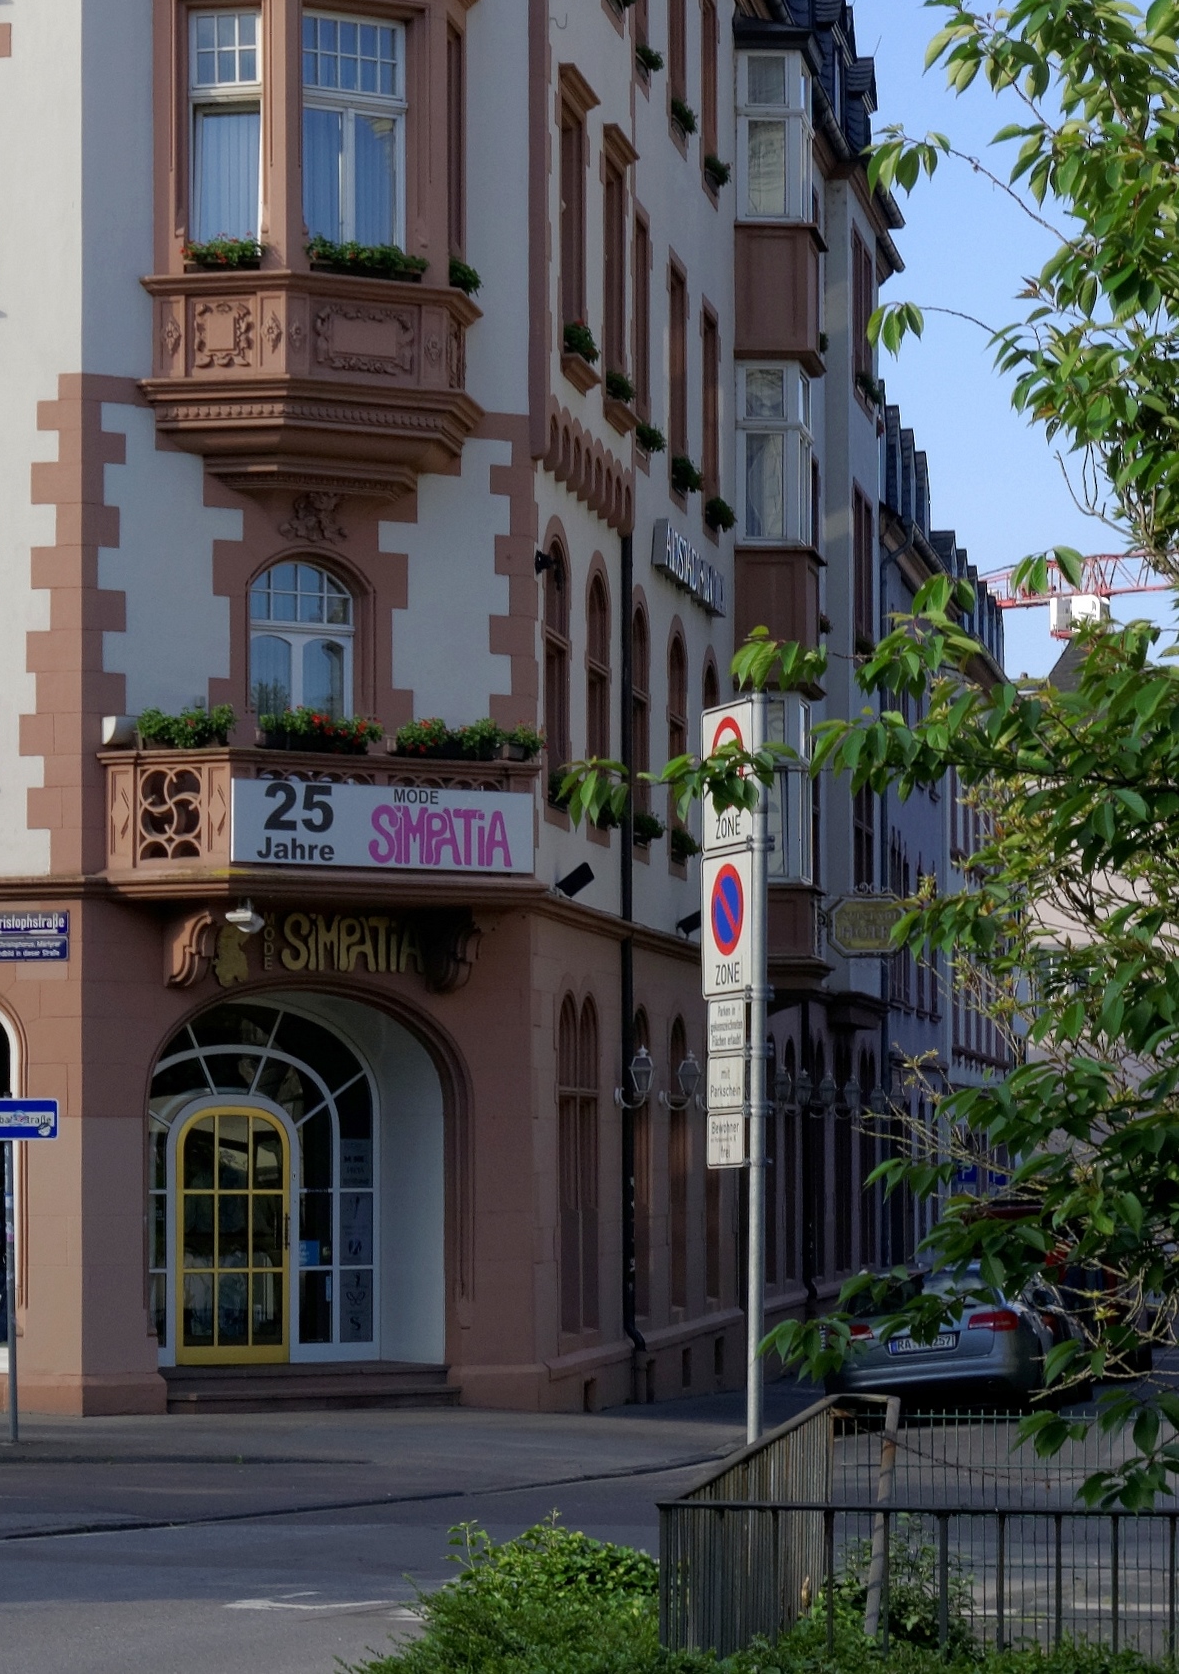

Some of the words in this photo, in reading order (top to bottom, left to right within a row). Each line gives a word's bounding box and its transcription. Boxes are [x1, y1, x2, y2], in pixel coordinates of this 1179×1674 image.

[264, 783, 334, 833] 25
[393, 788, 439, 805] MODE
[715, 814, 741, 840] ZONE
[257, 837, 335, 861] Jahre
[715, 962, 740, 986] ZONE
[710, 1085, 741, 1098] Parkschein
[711, 1121, 740, 1134] Bewohner
